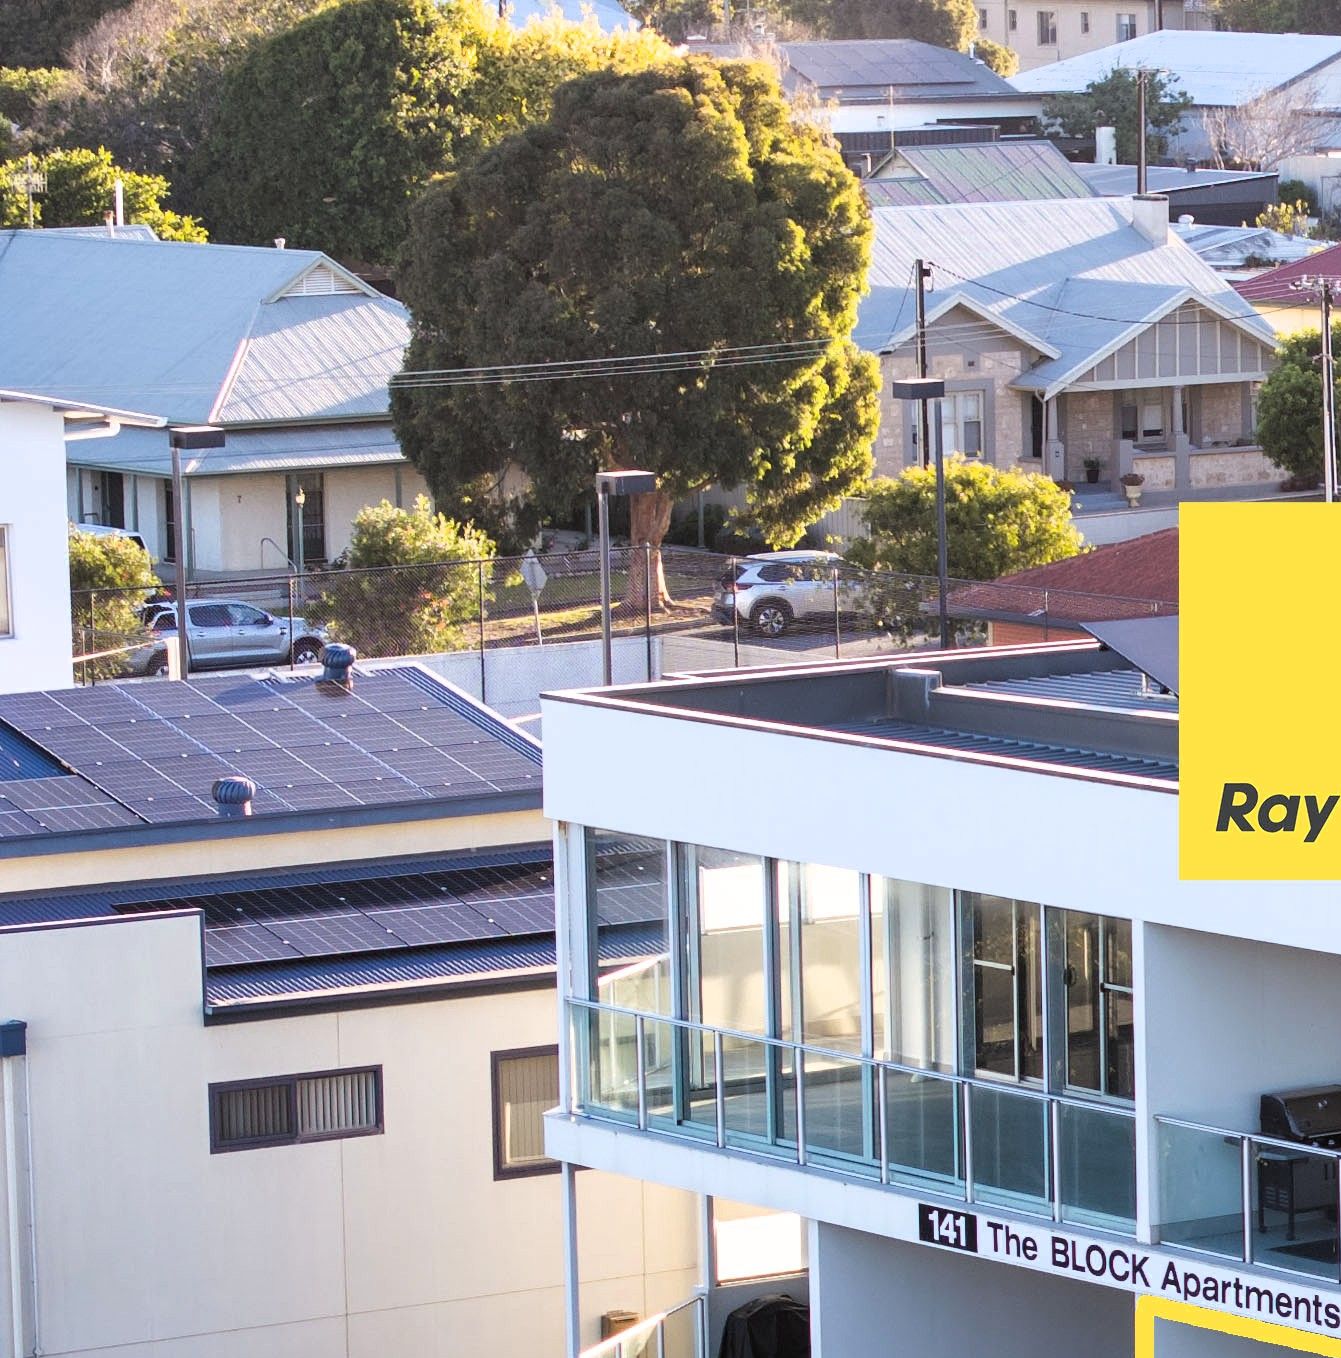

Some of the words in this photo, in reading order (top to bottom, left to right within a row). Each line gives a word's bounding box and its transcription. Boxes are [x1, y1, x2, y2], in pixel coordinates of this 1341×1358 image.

[927, 1209, 968, 1248] 141
[987, 1221, 1038, 1261] The
[1051, 1236, 1151, 1288] BLOCK
[1161, 1261, 1341, 1330] Apartments
